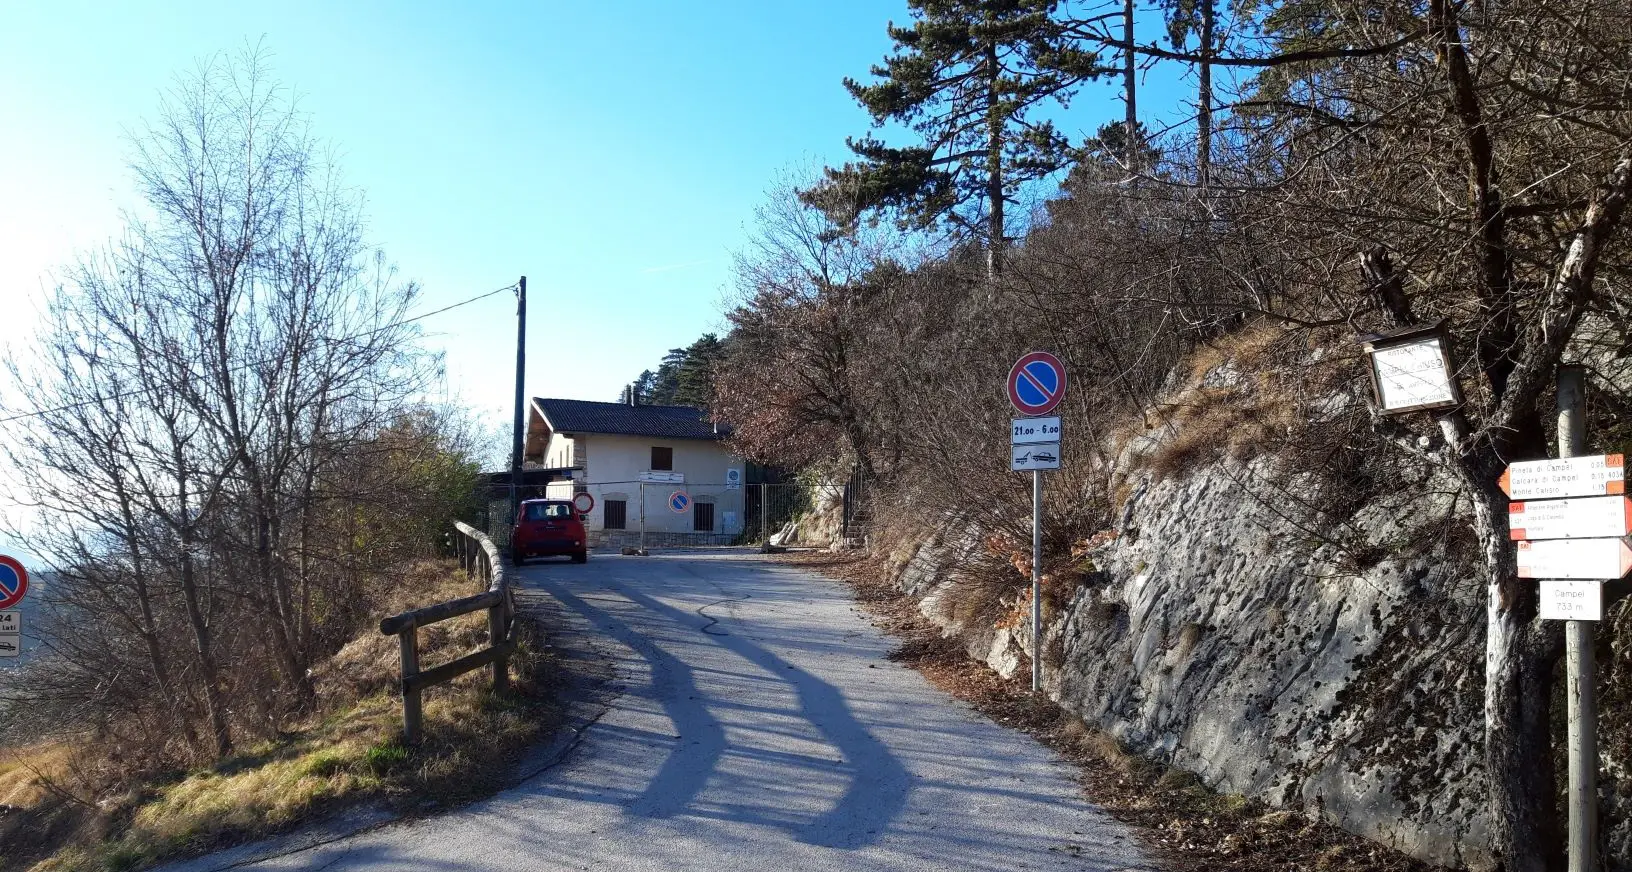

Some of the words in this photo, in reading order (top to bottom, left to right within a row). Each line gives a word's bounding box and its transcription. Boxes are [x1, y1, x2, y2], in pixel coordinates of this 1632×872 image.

[1014, 426, 1034, 436] 21.00
[1042, 424, 1059, 434] 6.00
[1512, 487, 1532, 496] Monte
[1554, 589, 1585, 599] Campel
[1556, 602, 1573, 611] 733
[1575, 603, 1584, 611] m
